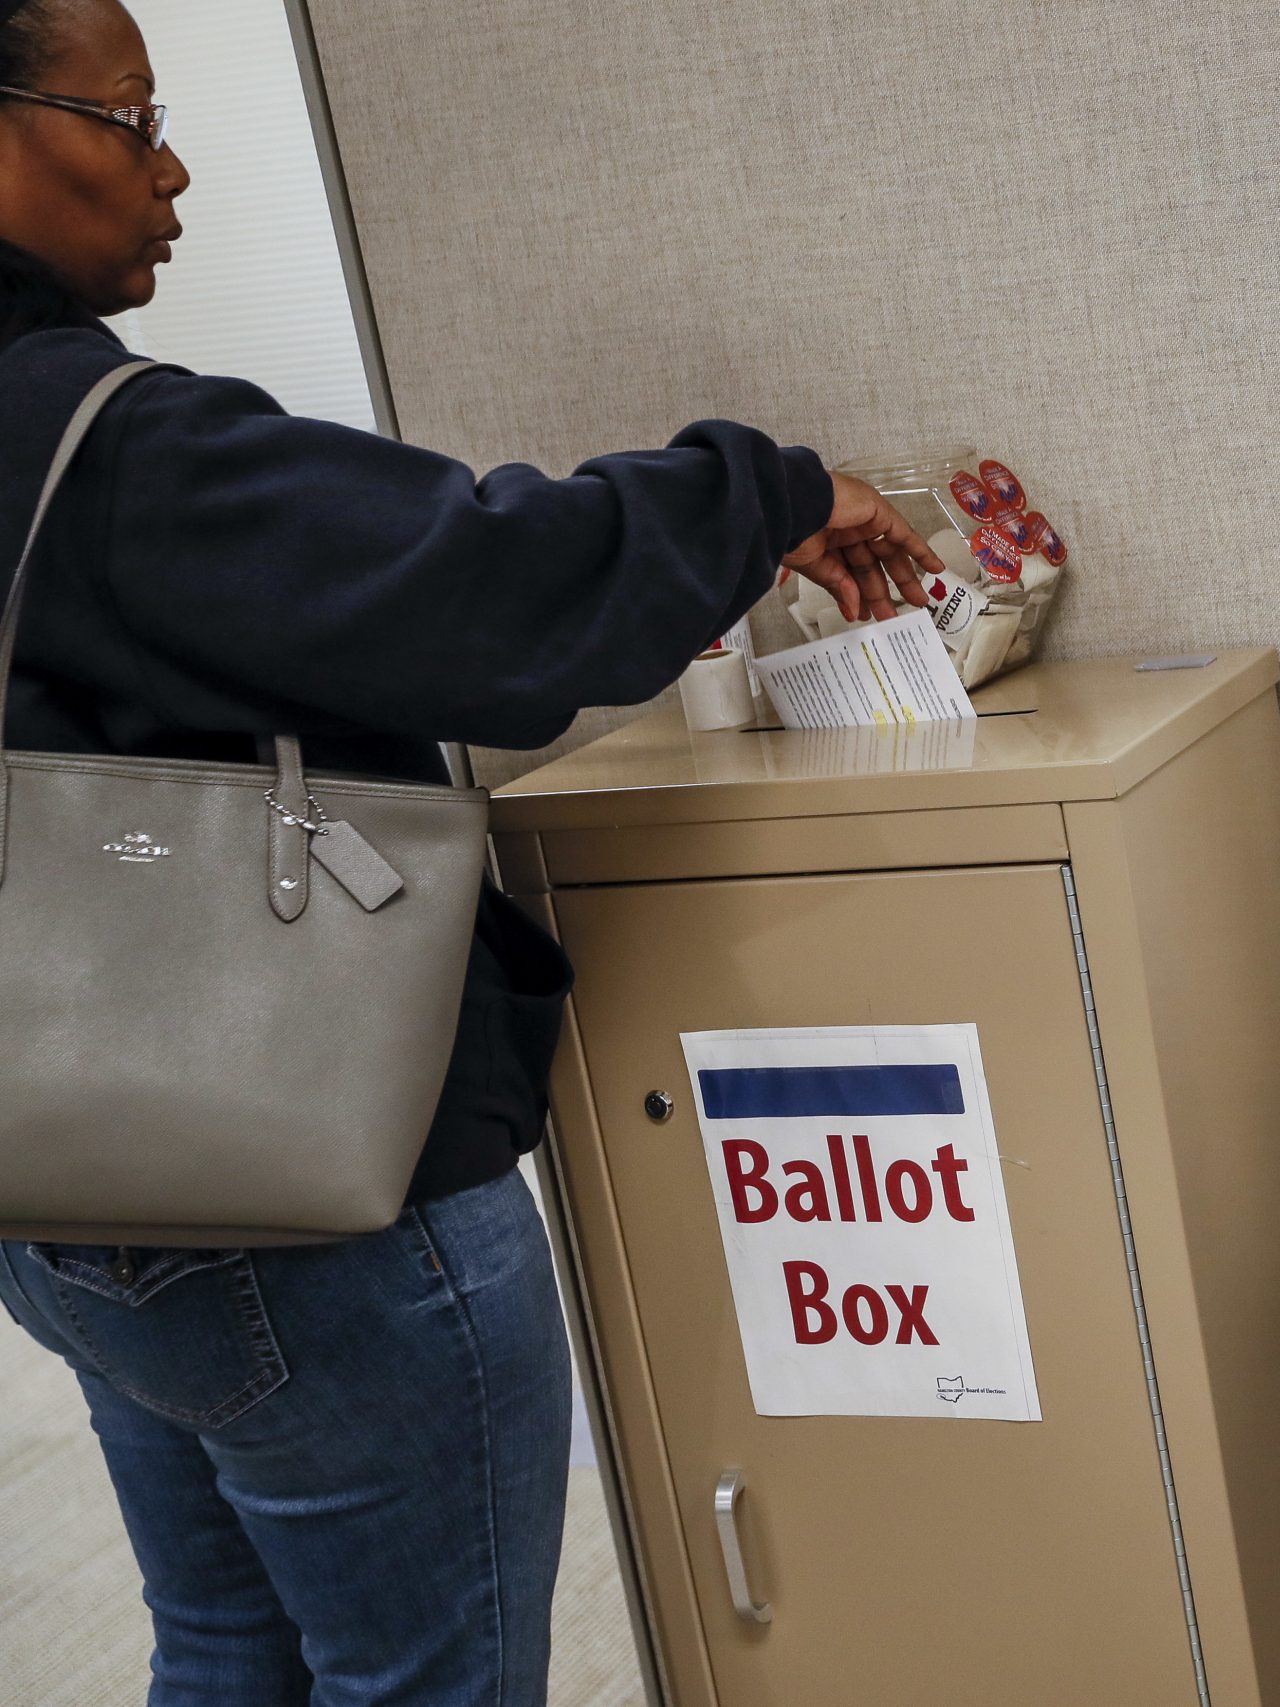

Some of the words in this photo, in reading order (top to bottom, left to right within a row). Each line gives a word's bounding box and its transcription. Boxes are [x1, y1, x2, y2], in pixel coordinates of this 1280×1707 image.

[936, 586, 967, 631] VOTING
[721, 1134, 976, 1224] Ballot
[782, 1260, 941, 1346] Box
